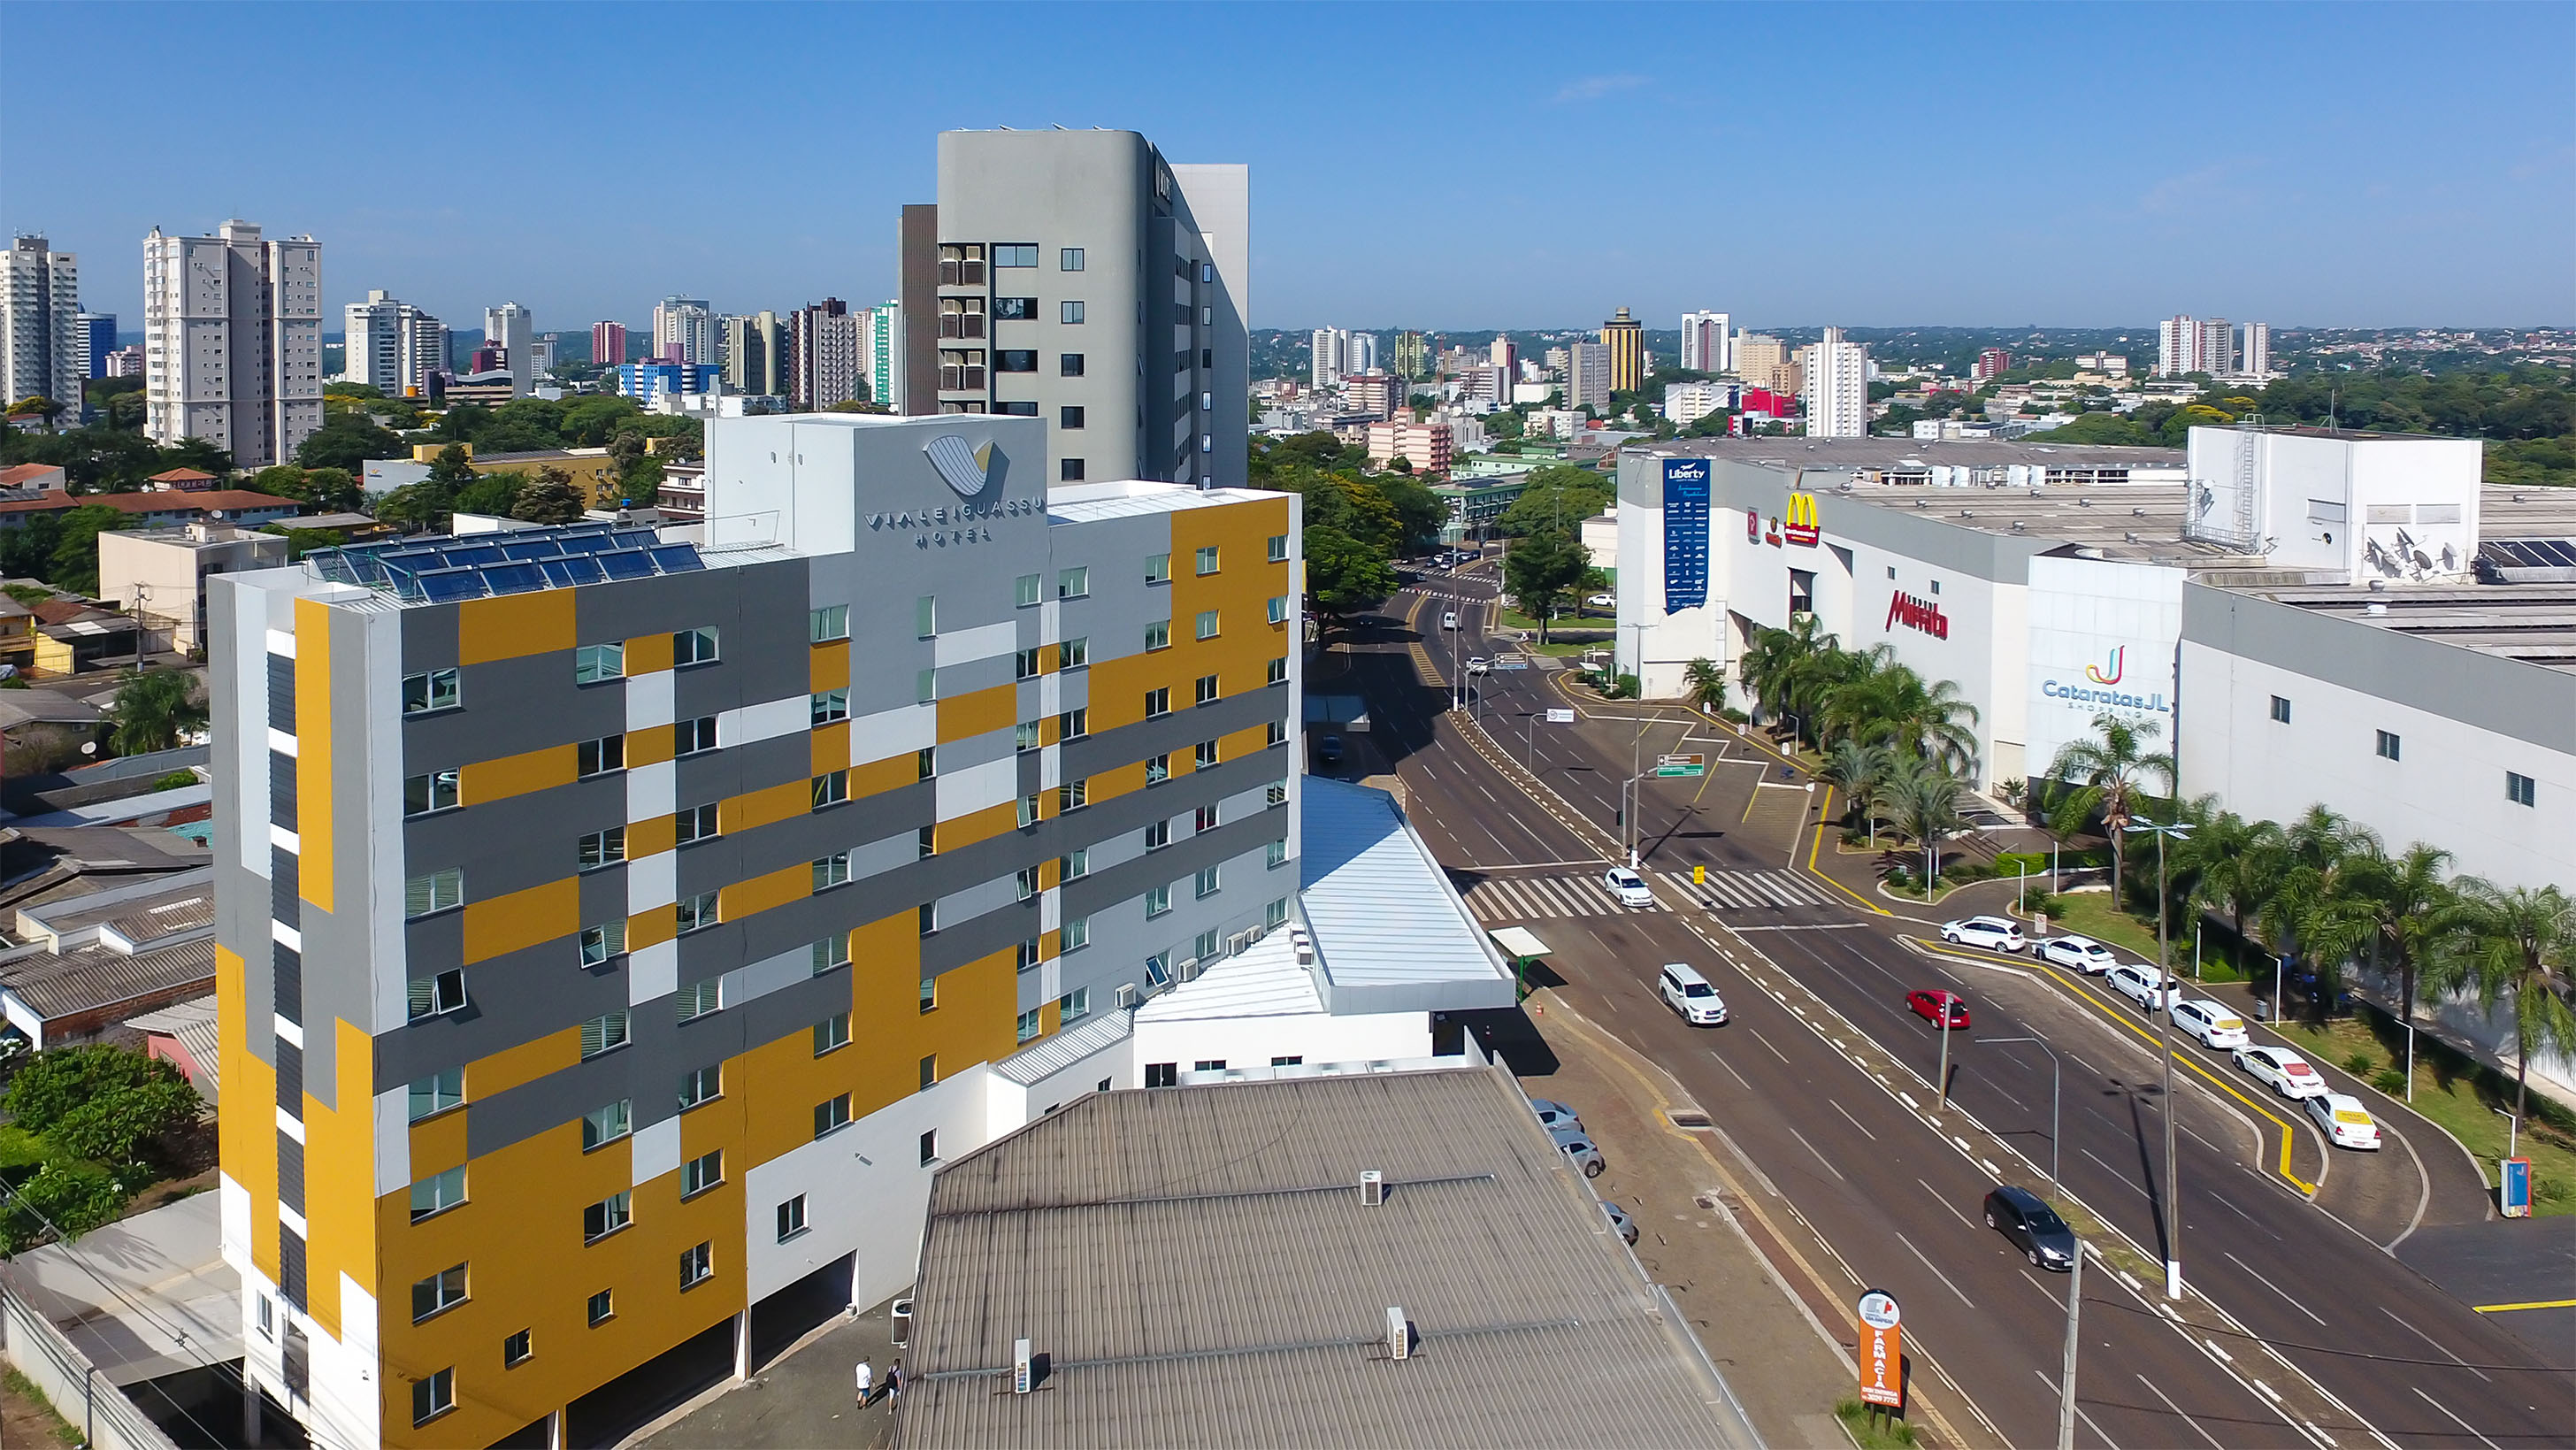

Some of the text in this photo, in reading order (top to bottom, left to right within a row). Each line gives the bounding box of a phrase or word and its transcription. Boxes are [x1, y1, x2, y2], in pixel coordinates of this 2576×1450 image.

[1668, 468, 1706, 479] Liberty
[916, 526, 989, 544] HOTEL
[2067, 702, 2142, 718] SHOPPING
